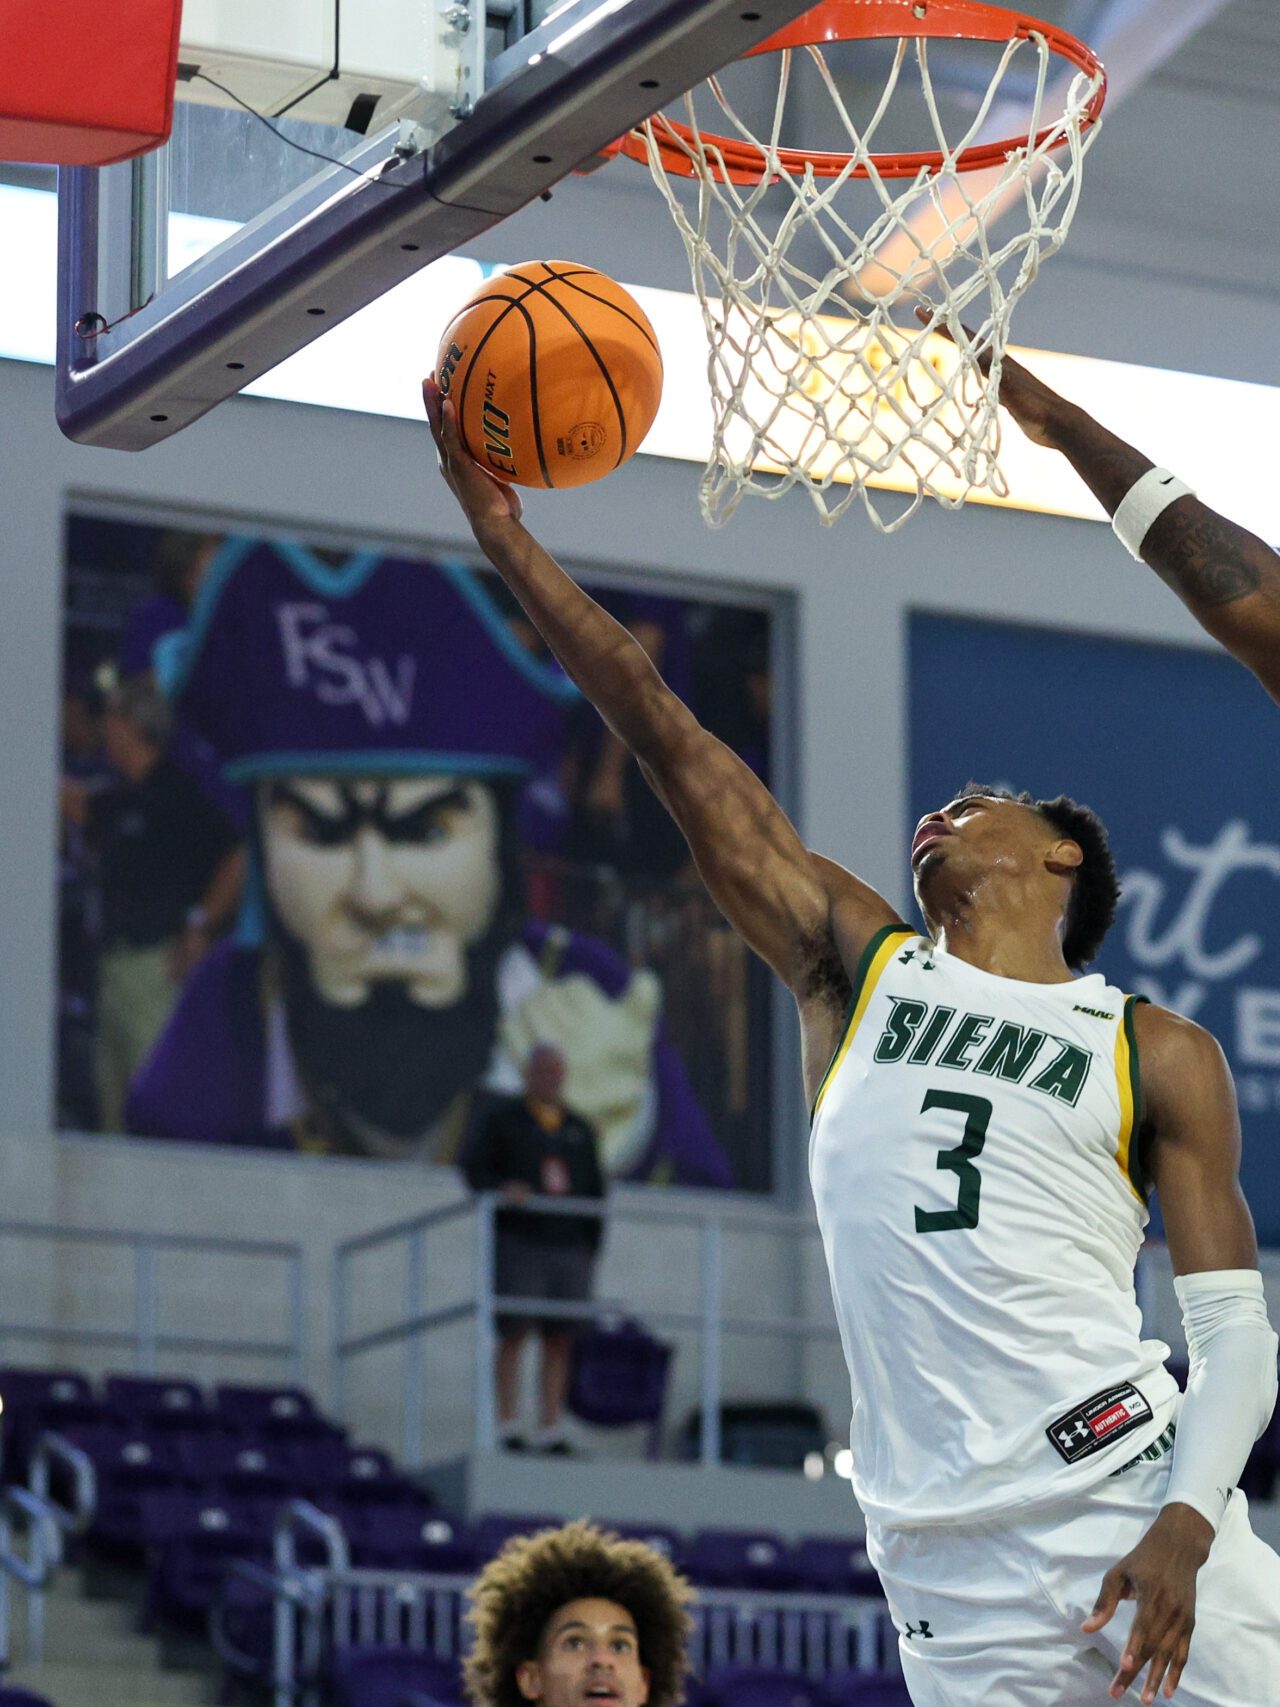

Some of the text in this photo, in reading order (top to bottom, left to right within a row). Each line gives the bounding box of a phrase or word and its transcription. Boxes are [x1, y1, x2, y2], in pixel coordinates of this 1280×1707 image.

[482, 368, 518, 478] EVO NXT
[276, 602, 418, 728] FSW
[873, 994, 1094, 1109] SIENA
[914, 1088, 993, 1234] 3
[1085, 1400, 1108, 1417] UNDER
[1094, 1408, 1126, 1433] AUTHENTIC
